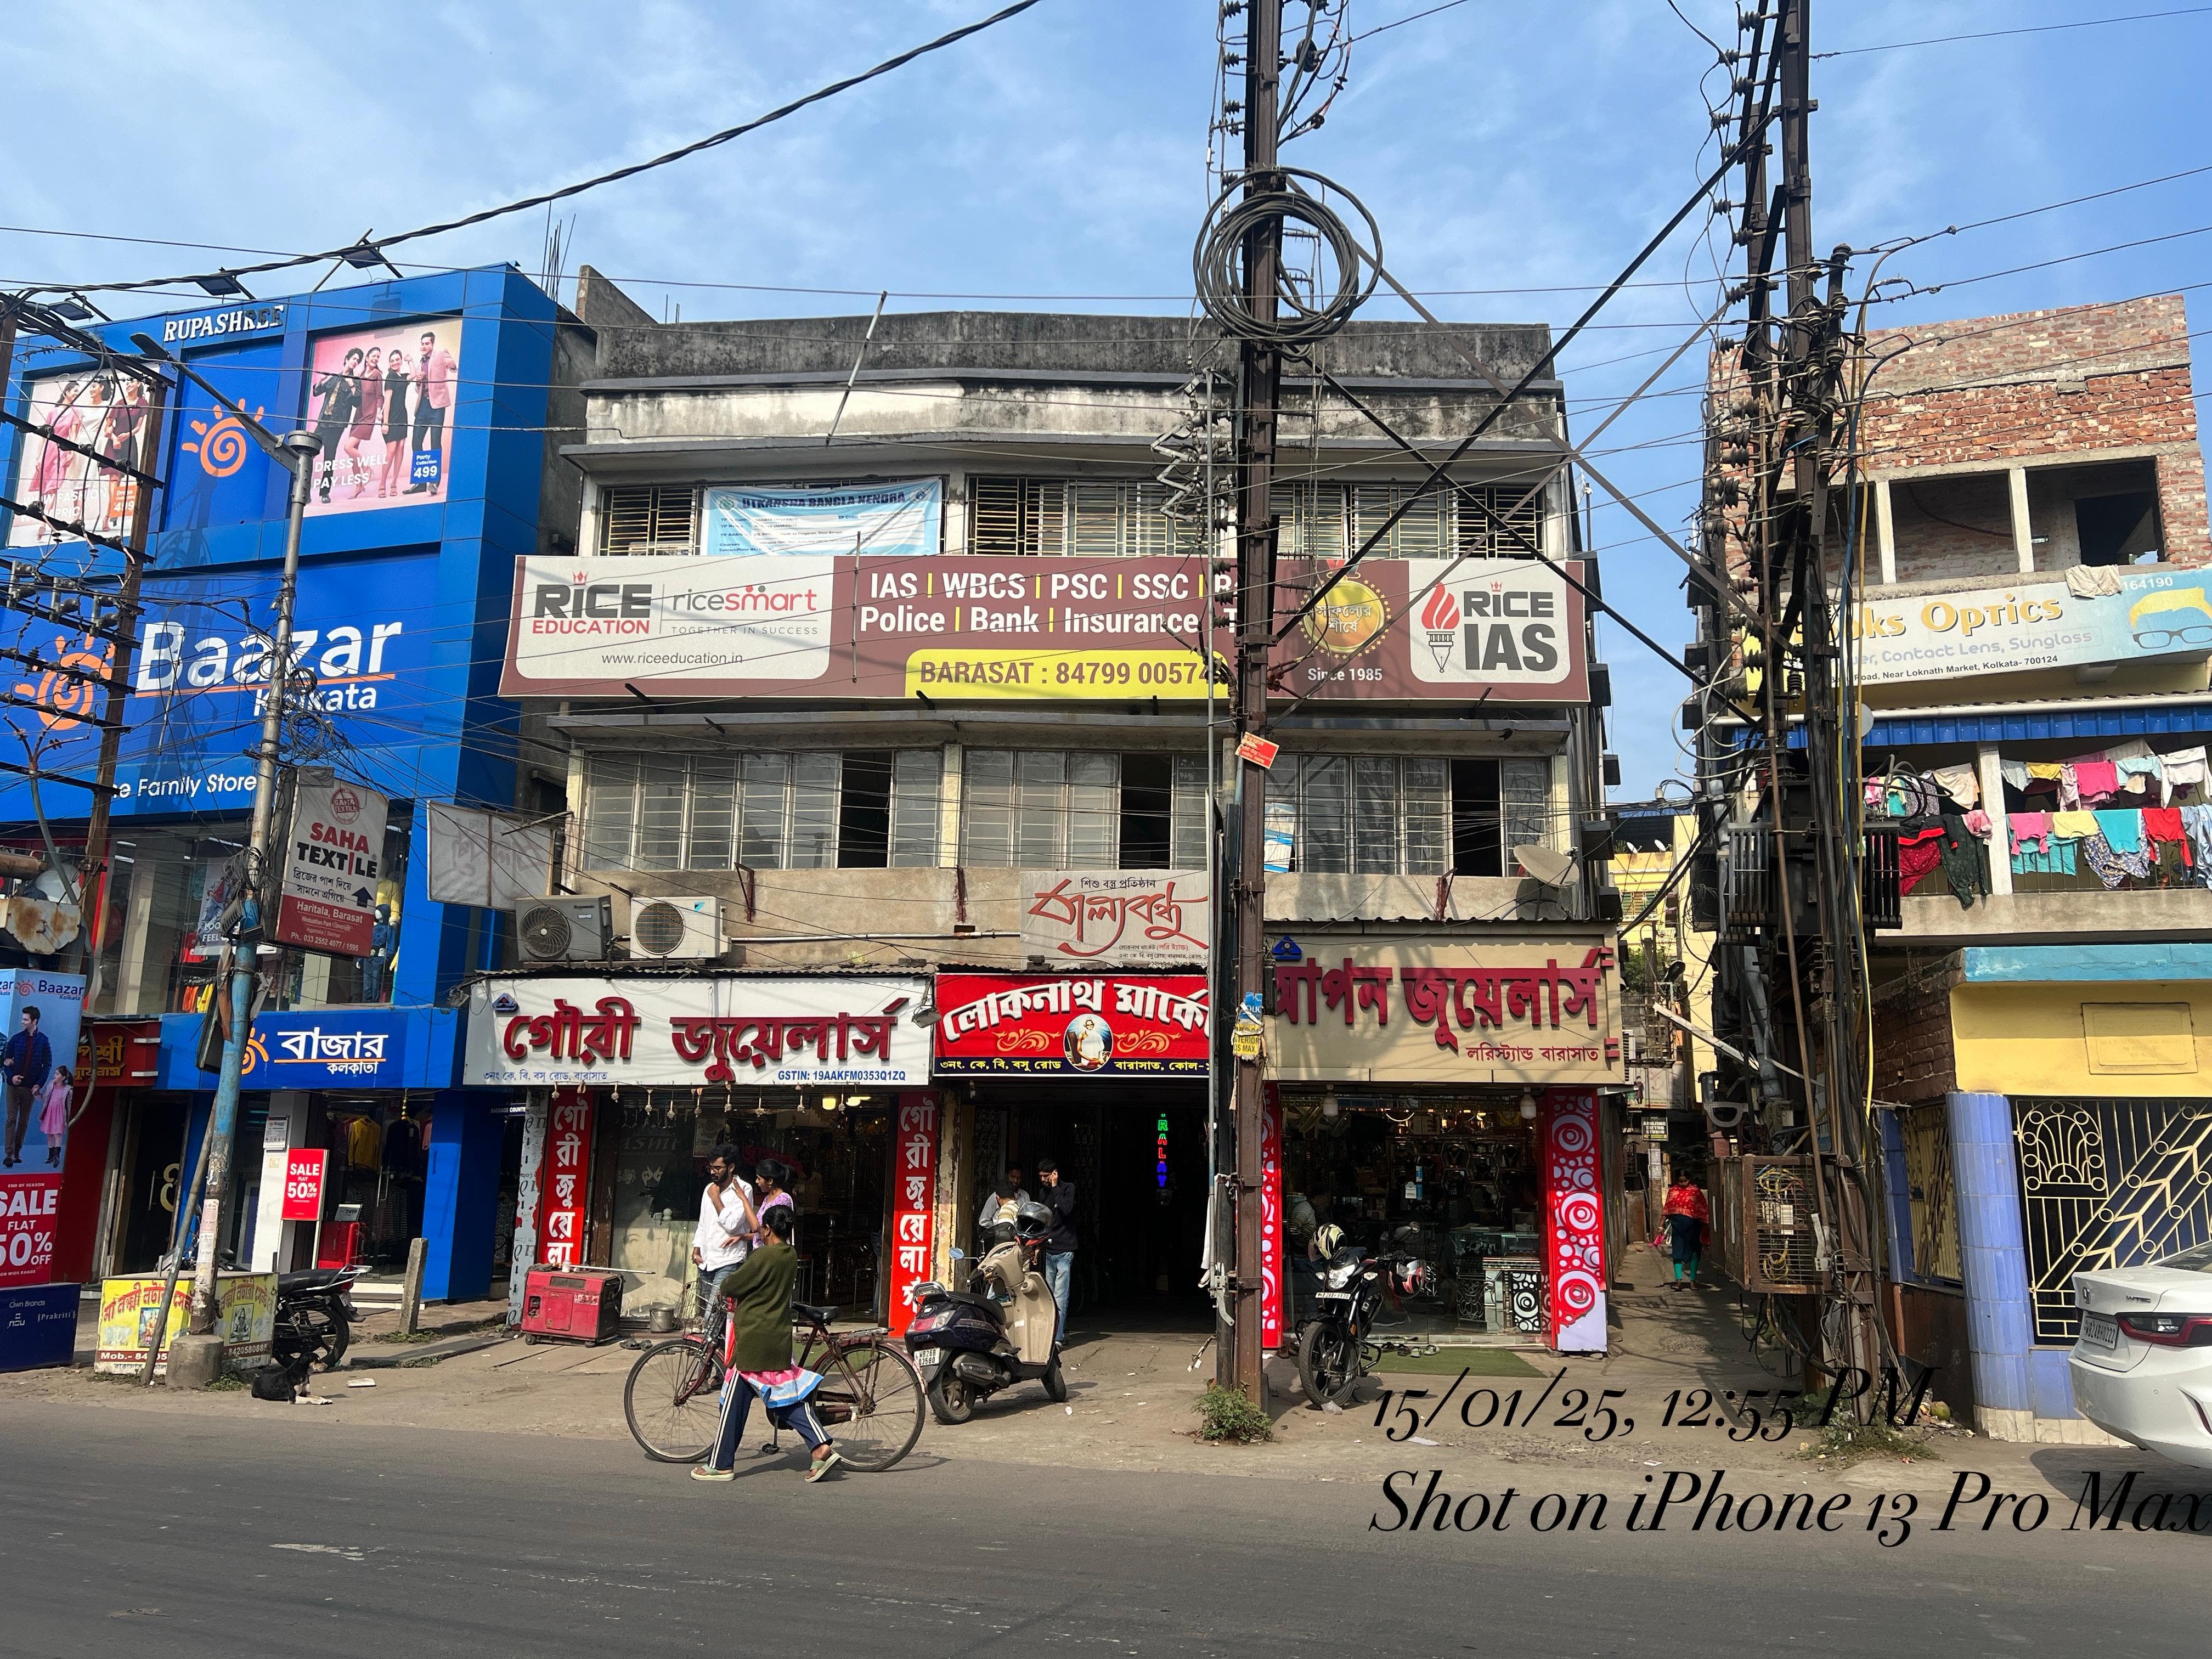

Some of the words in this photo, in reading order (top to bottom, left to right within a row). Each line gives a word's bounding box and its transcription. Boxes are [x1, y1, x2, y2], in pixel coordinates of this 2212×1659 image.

[164, 306, 285, 342] RUPASHREE
[315, 458, 353, 472] DRESS
[357, 455, 388, 467] WELL
[313, 476, 338, 489] PAY
[341, 472, 369, 486] LESS
[57, 487, 108, 501] FASHION
[742, 497, 805, 510] UTKARSHA
[808, 495, 855, 507] BANGLA
[858, 492, 905, 505] KENDRA
[870, 573, 917, 599] IAS
[943, 573, 1026, 599] WBCS
[1051, 574, 1108, 600] PSC
[1132, 574, 1189, 600] SSC
[673, 585, 817, 611] ricesmart
[533, 620, 650, 634] EDUCATION
[860, 605, 945, 632] Police
[970, 606, 1040, 633] Bank
[1064, 607, 1199, 633] Insurance
[672, 627, 737, 635] TOGETHER
[743, 627, 755, 635] IN
[761, 627, 817, 635] SUCCESS
[1464, 623, 1558, 672] IAS
[1882, 644, 1954, 662] Contact
[1960, 640, 2005, 656] Lens,
[2009, 631, 2092, 651] Sunglass
[136, 620, 402, 692] Baazar
[602, 653, 743, 664] www.riceeducation.in
[921, 662, 1034, 684] BARASAT
[1056, 662, 1131, 684] 84799
[1308, 668, 1345, 681] Since
[1348, 668, 1383, 681] 1985
[1883, 670, 1905, 679] Near
[1906, 667, 1943, 677] Loknath
[1946, 663, 1980, 674] Market,
[1983, 659, 2022, 670] Kolkata-
[2024, 655, 2058, 665] 700124
[138, 776, 201, 798] Family
[207, 774, 257, 793] Store
[309, 822, 370, 855] SAHA
[297, 842, 378, 879] TEXTILE
[293, 867, 317, 883] ব্রিজের
[320, 876, 334, 887] পাশ
[336, 877, 352, 891] দিয়ে
[1081, 878, 1100, 888] শিশু
[1103, 879, 1116, 889] বস্ত্র
[1119, 877, 1156, 888] প্রতিষ্ঠান
[297, 884, 320, 897] সামনে
[321, 889, 345, 904] এগিয়ে
[297, 901, 331, 917] Haritala,
[333, 909, 363, 923] Barasat
[205, 922, 222, 931] LOO
[202, 934, 219, 942] FEEL
[315, 936, 328, 945] 2552
[38, 980, 84, 995] Baazar
[1401, 947, 1601, 1052] জুয়েলার্স
[943, 980, 1105, 1041] লোকনাথ
[1114, 983, 1210, 1039] মার্কে
[277, 1026, 389, 1060] বাজার
[504, 997, 641, 1065] গৌরী
[670, 997, 910, 1083] জুয়েলার্স
[1235, 1035, 1260, 1045] NTERIOR
[1541, 1045, 1599, 1063] বারাসাত
[326, 1060, 379, 1075] কলকাতা
[969, 1061, 989, 1070] কে,
[992, 1058, 1009, 1070] বি,
[1012, 1061, 1031, 1072] বসু
[1034, 1061, 1062, 1070] রোড
[1114, 1061, 1164, 1071] বারাসাত,
[484, 1071, 499, 1080] ৩নং
[533, 1071, 546, 1083] বসু
[574, 1071, 608, 1080] বারাসাত
[778, 1070, 810, 1081] GSTIN:
[813, 1070, 906, 1081] 19AAKFM0353Q1ZQ
[290, 1163, 320, 1176] SALE
[287, 1182, 318, 1199] 50%
[8, 1220, 36, 1231] FLAT
[31, 1254, 52, 1265] OFF
